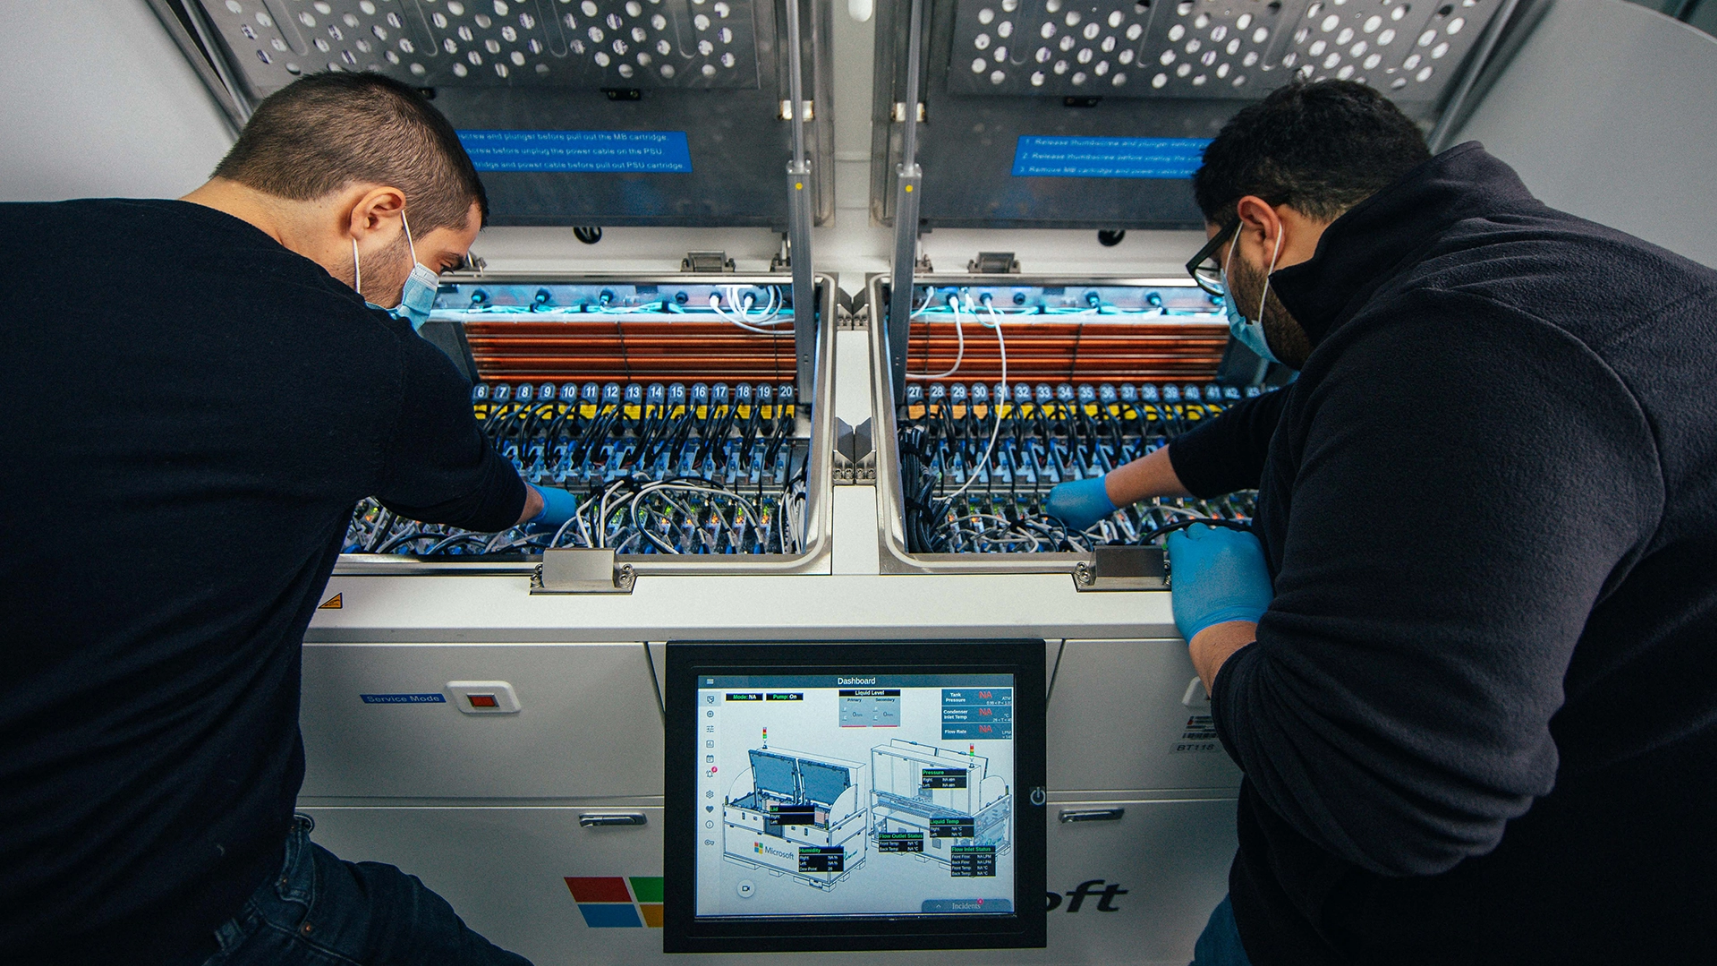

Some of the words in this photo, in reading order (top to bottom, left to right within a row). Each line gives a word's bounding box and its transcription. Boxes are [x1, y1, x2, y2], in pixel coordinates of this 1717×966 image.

[537, 131, 565, 141] before
[582, 133, 597, 141] out
[598, 132, 612, 141] the
[613, 133, 627, 141] MB
[492, 146, 520, 155] before
[550, 147, 564, 155] the
[565, 148, 591, 157] power
[592, 148, 615, 156] cable
[616, 148, 627, 156] on
[628, 147, 642, 156] the
[517, 161, 542, 170] power
[544, 161, 567, 170] cable
[567, 161, 594, 170] before
[595, 162, 611, 171] pull
[612, 162, 626, 170] out
[626, 162, 645, 170] PSU
[477, 386, 485, 398] 6
[499, 386, 507, 398] 7
[521, 386, 529, 398] 8
[544, 386, 551, 398] 9
[564, 386, 575, 397] 10
[586, 386, 596, 397] 11
[606, 386, 618, 397] 12
[628, 386, 640, 398] 13
[650, 386, 662, 397] 14
[671, 386, 683, 397] 15
[694, 386, 706, 397] 16
[715, 386, 726, 397] 17
[738, 386, 750, 397] 18
[759, 386, 771, 397] 19
[780, 386, 792, 397] 20
[909, 386, 921, 397] 27
[931, 385, 944, 397] 28
[953, 386, 965, 398] 29
[974, 386, 986, 397] 30
[1017, 386, 1029, 397] 32
[1038, 386, 1050, 398] 33
[1059, 385, 1071, 397] 34
[1080, 386, 1093, 398] 35
[1100, 386, 1115, 398] 36
[1122, 386, 1135, 398] 37
[1142, 386, 1157, 398] 38
[837, 677, 876, 685] Dashboard
[772, 693, 789, 701] Pump:
[854, 689, 871, 697] Liquid
[978, 690, 993, 699] NA
[366, 695, 408, 703] Service
[978, 707, 993, 716] NA
[978, 724, 993, 733] NA
[1176, 744, 1215, 752] BT118
[764, 845, 795, 861] Microsoft
[952, 902, 981, 910] Incidents
